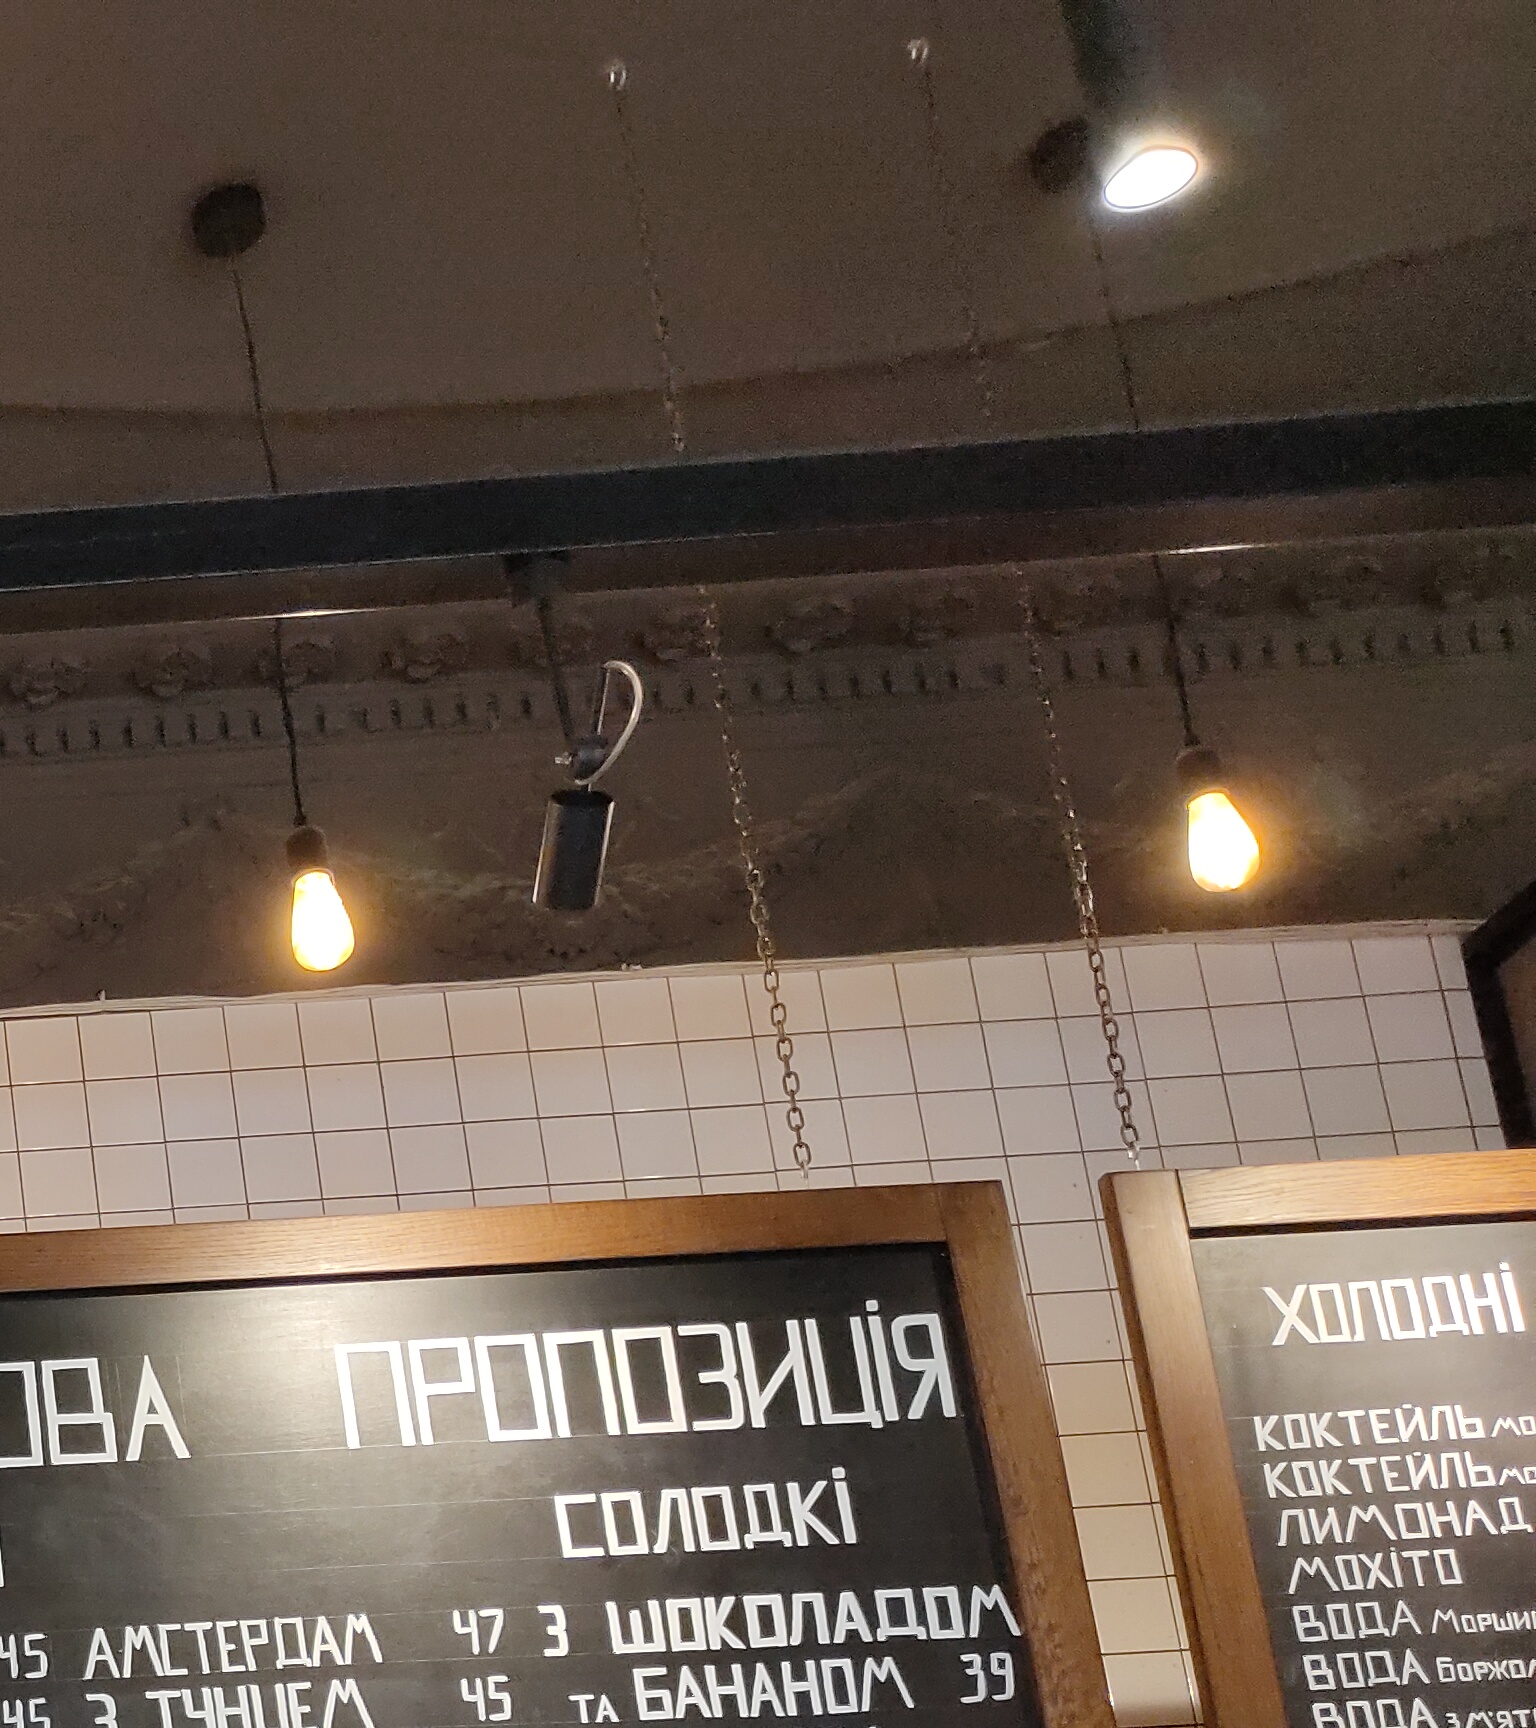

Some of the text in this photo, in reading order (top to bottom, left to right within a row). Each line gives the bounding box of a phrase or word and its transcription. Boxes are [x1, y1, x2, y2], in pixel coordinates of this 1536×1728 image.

[1262, 1261, 1526, 1346] ХОЛОДНІ
[342, 1299, 958, 1450] ПРОПОЗИЦІЯ
[1252, 1403, 1486, 1452] КОКТЕЙЛЬ
[1262, 1450, 1497, 1499] КОКТЕЙЛЬ
[553, 1466, 858, 1559] СОЛОДКІ
[1277, 1496, 1534, 1547] ЛИМОНАД
[1287, 1546, 1464, 1595] МОХІТО
[81, 1607, 504, 1681] АМСТЕРДАМ 47
[604, 1583, 1022, 1655] ШОКОЛАДОМ
[1290, 1599, 1422, 1643] ВОДА
[631, 1651, 1016, 1721] БАНАНОМ 39
[1301, 1647, 1431, 1691] ВОДА
[459, 1674, 512, 1722] 45
